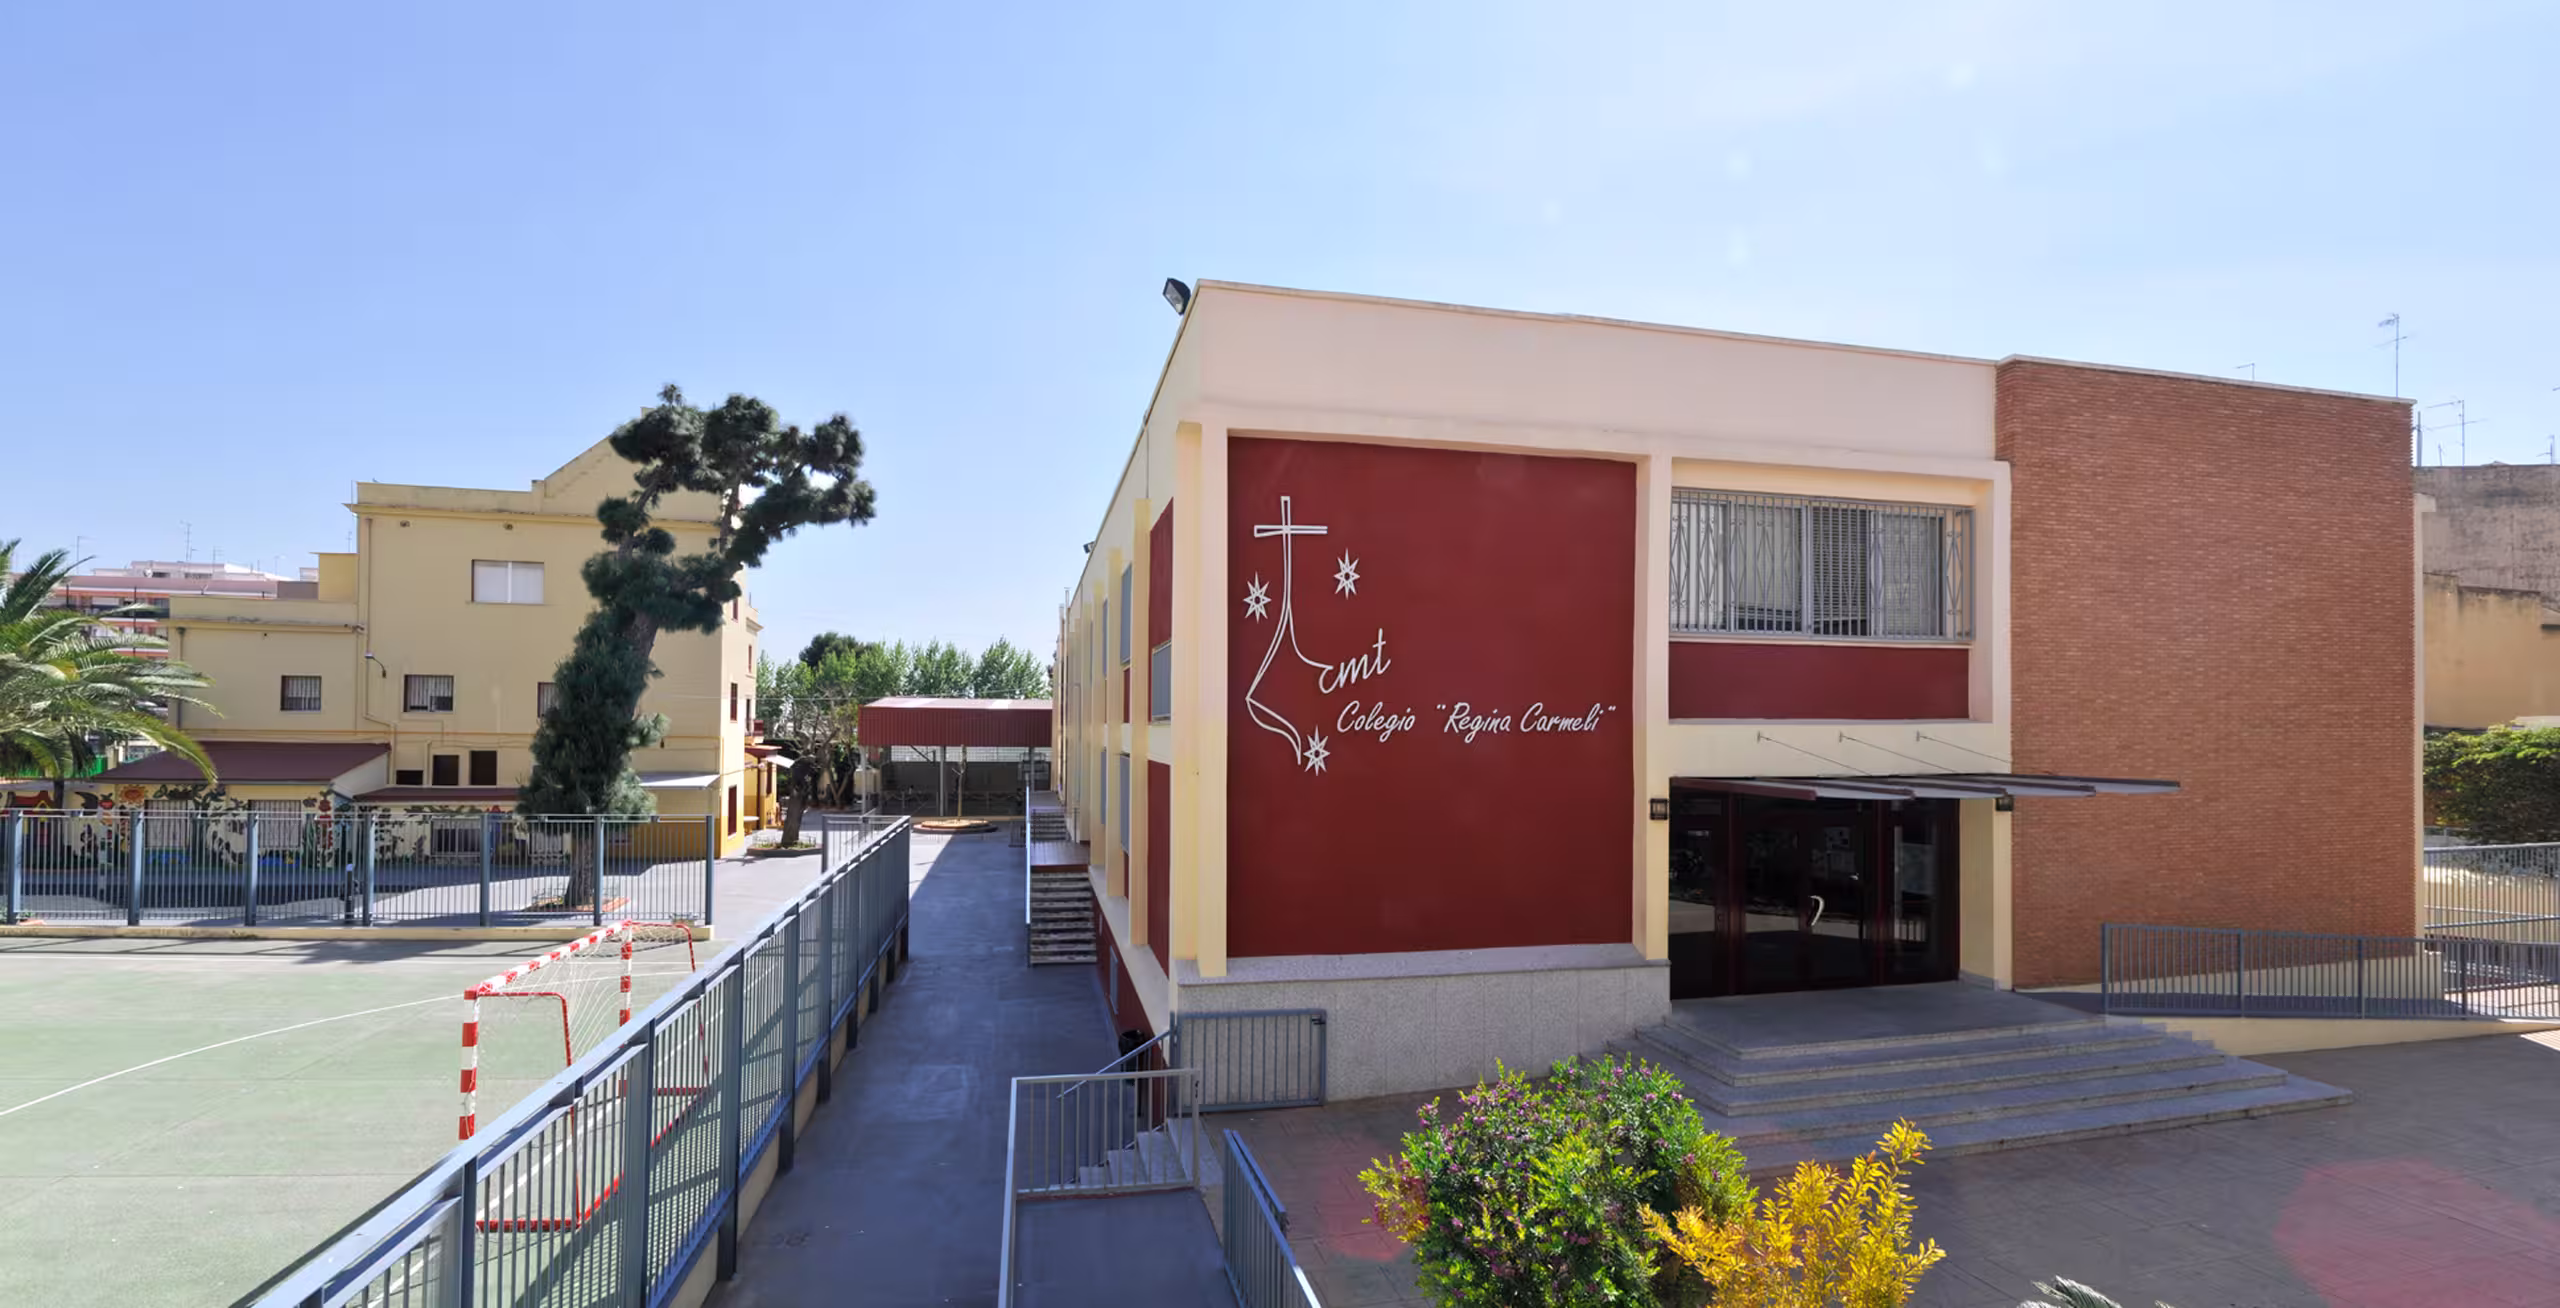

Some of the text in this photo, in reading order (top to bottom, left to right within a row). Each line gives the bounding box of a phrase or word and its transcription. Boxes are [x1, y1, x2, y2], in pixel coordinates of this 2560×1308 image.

[1336, 700, 1617, 743] Colegio "Regina Carmeli"
